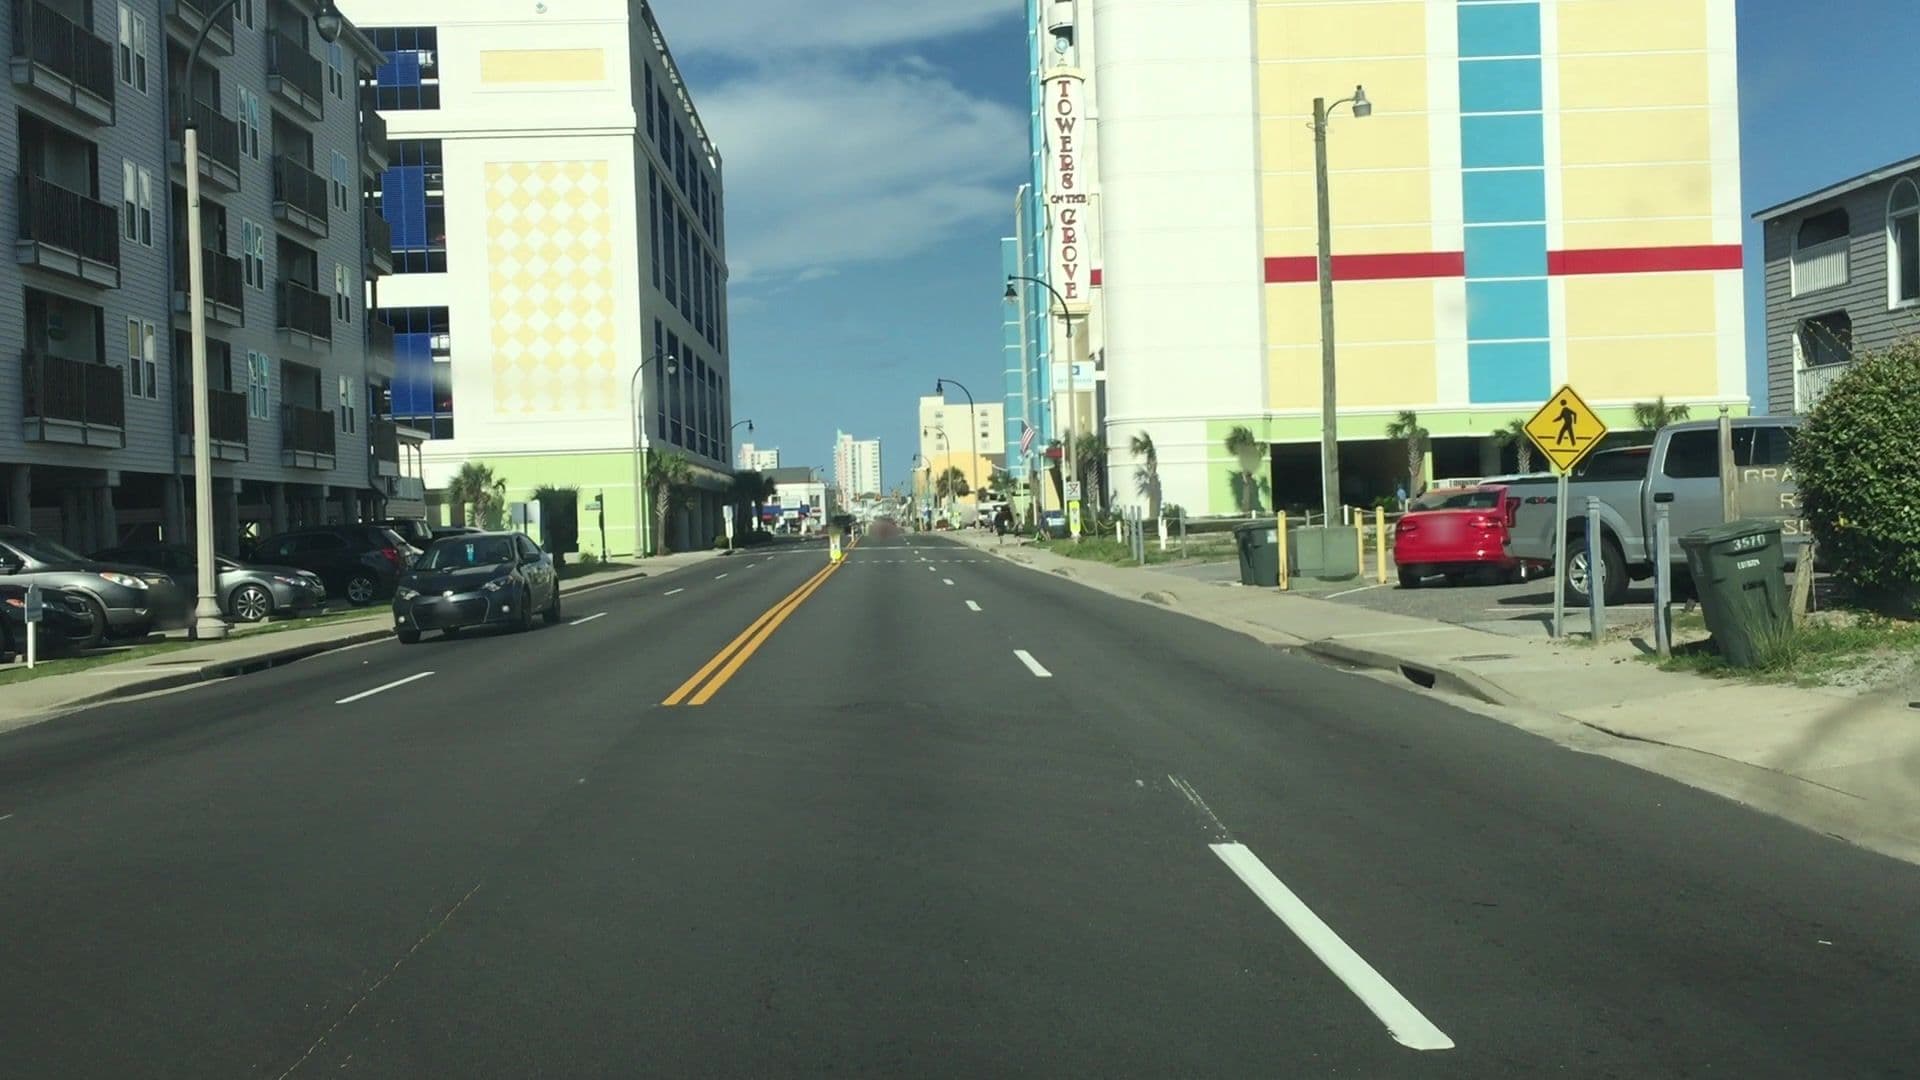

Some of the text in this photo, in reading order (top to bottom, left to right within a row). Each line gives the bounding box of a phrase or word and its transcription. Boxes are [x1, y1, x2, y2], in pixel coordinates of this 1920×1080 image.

[1055, 80, 1076, 190] TOWERS
[1050, 194, 1087, 204] ON THE
[1060, 208, 1078, 299] GROVE
